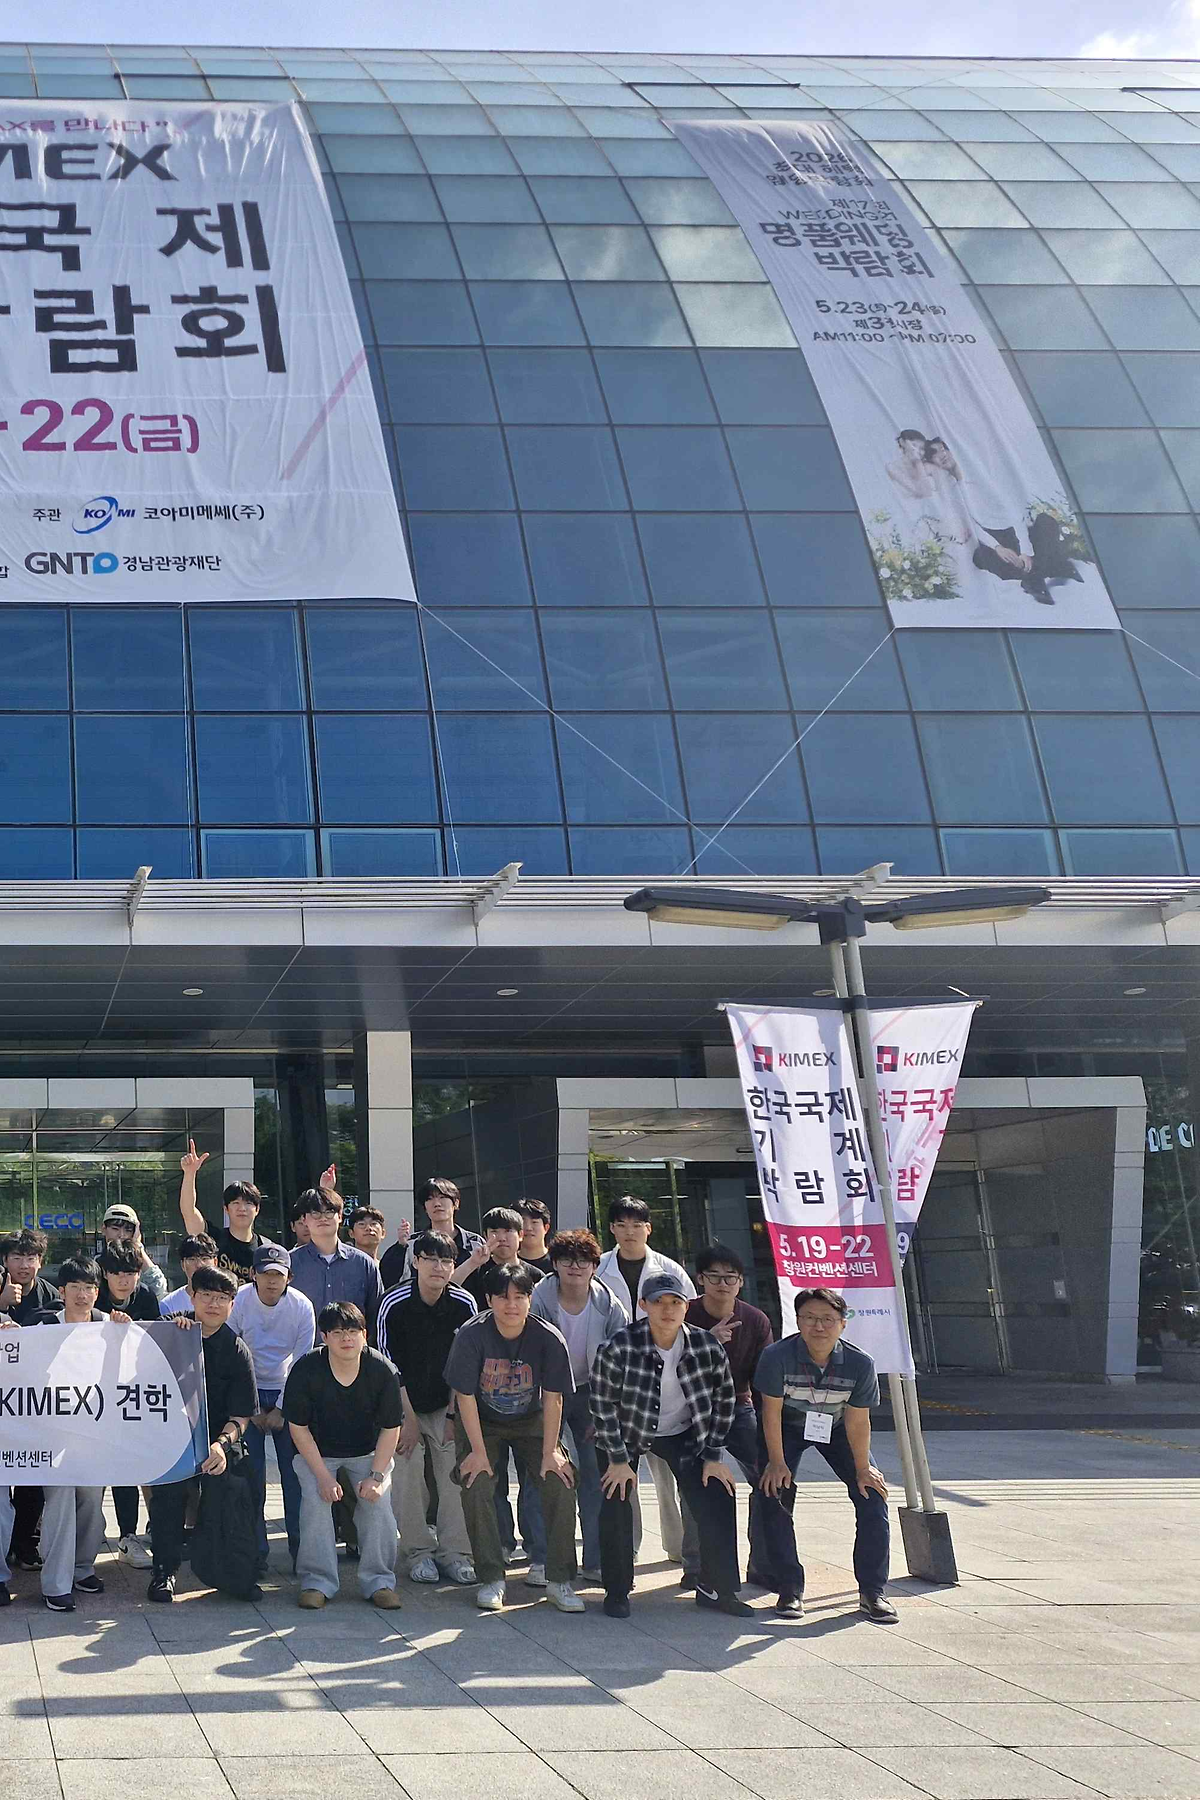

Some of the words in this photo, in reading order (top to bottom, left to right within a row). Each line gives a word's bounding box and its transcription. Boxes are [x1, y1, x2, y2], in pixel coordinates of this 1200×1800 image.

[759, 221, 915, 249] 명품웨딩
[813, 250, 936, 278] 박람회
[32, 509, 61, 522] 주관
[143, 504, 265, 522] 코아미메쎄(주)
[122, 555, 222, 572] 경남관광재단
[779, 1051, 838, 1067] KIMEX
[903, 1049, 960, 1067] KIMEX
[747, 1086, 858, 1125] 한국국제
[25, 1213, 85, 1229] CECO
[782, 1259, 878, 1278] 창원컨벤션센터
[115, 1383, 172, 1423] 견학
